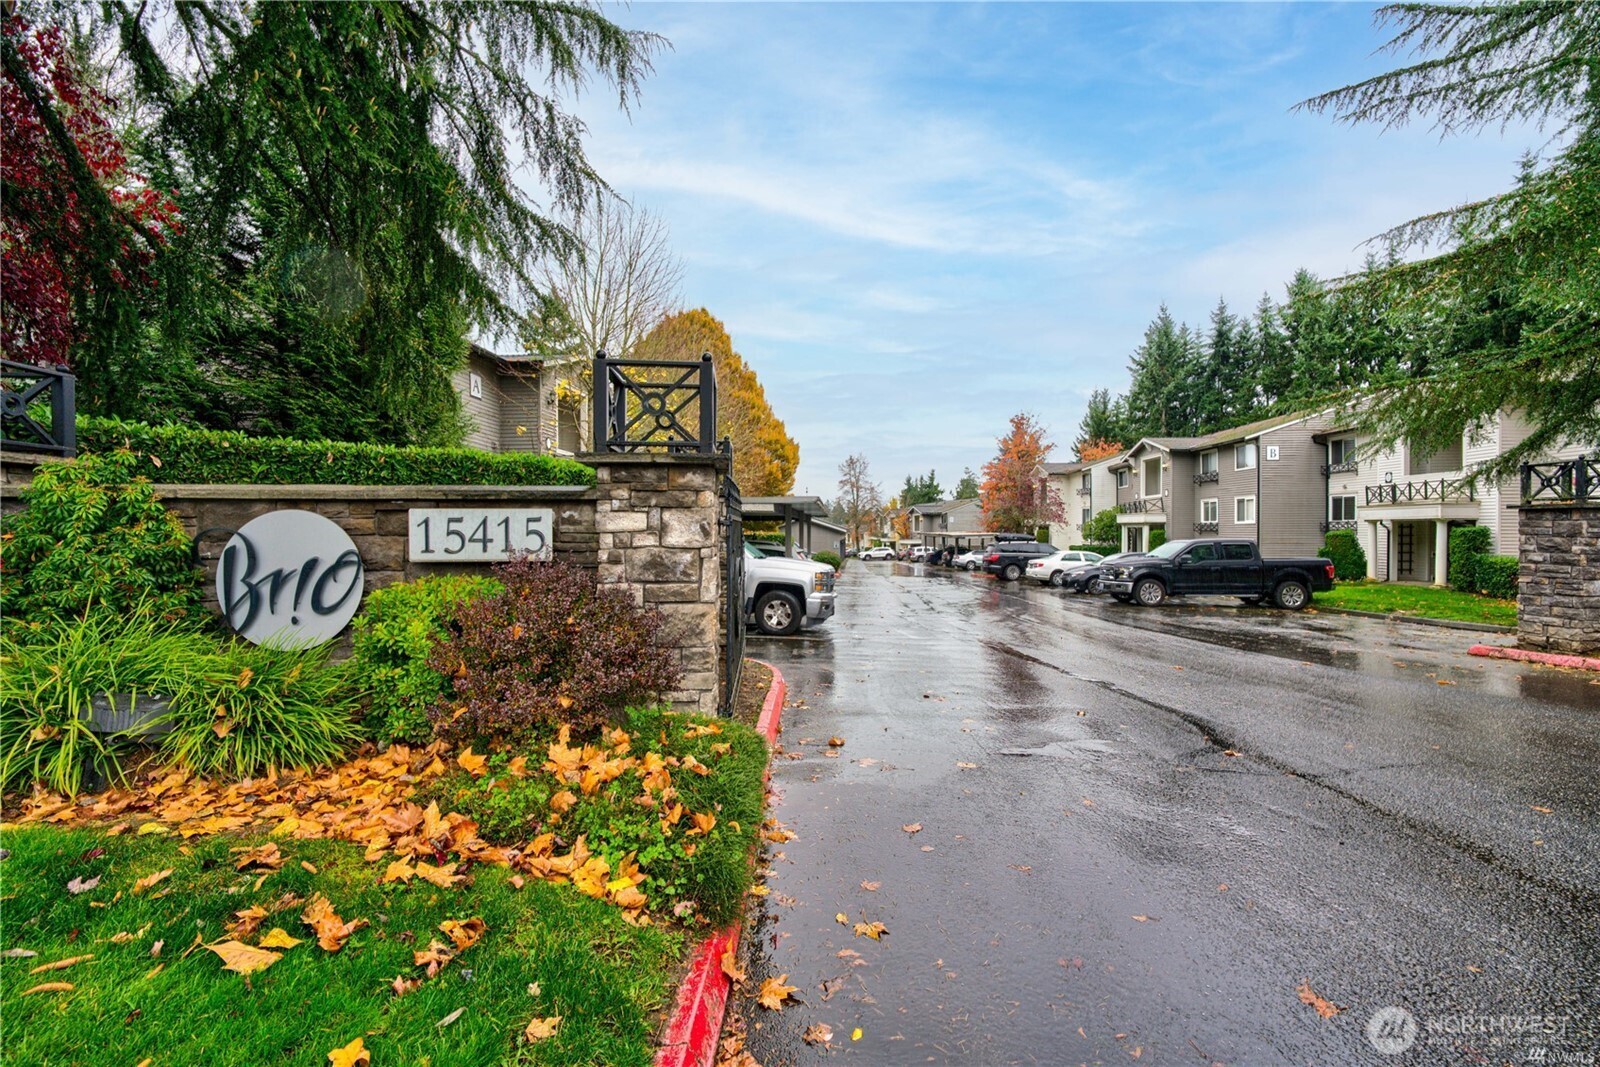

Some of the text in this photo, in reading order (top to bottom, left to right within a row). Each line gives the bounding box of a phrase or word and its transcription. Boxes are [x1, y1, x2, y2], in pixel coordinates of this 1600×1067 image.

[472, 379, 480, 394] A
[1270, 448, 1277, 458] B
[416, 515, 546, 554] 15415
